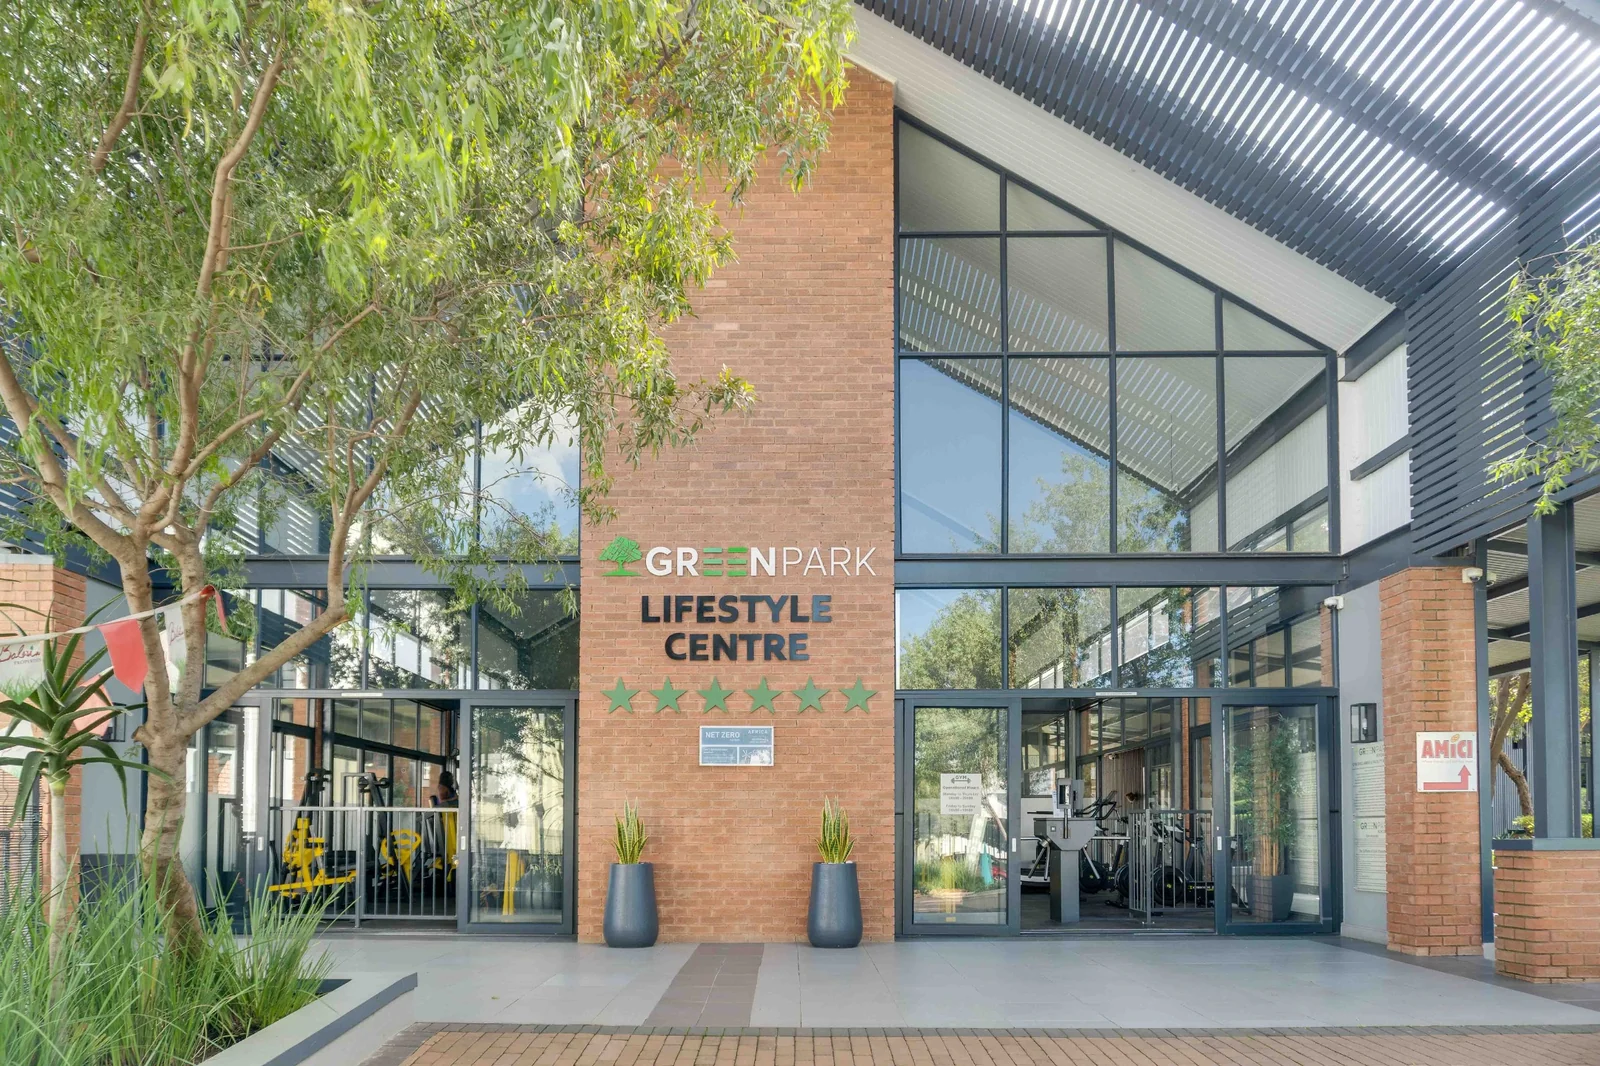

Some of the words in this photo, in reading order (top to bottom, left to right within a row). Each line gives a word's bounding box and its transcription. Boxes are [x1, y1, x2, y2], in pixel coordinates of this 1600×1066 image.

[645, 546, 877, 576] GREENPARK
[641, 595, 832, 623] LIFESTYLE
[664, 633, 810, 661] CENTRE
[705, 731, 720, 739] NET
[721, 731, 741, 739] ZERO
